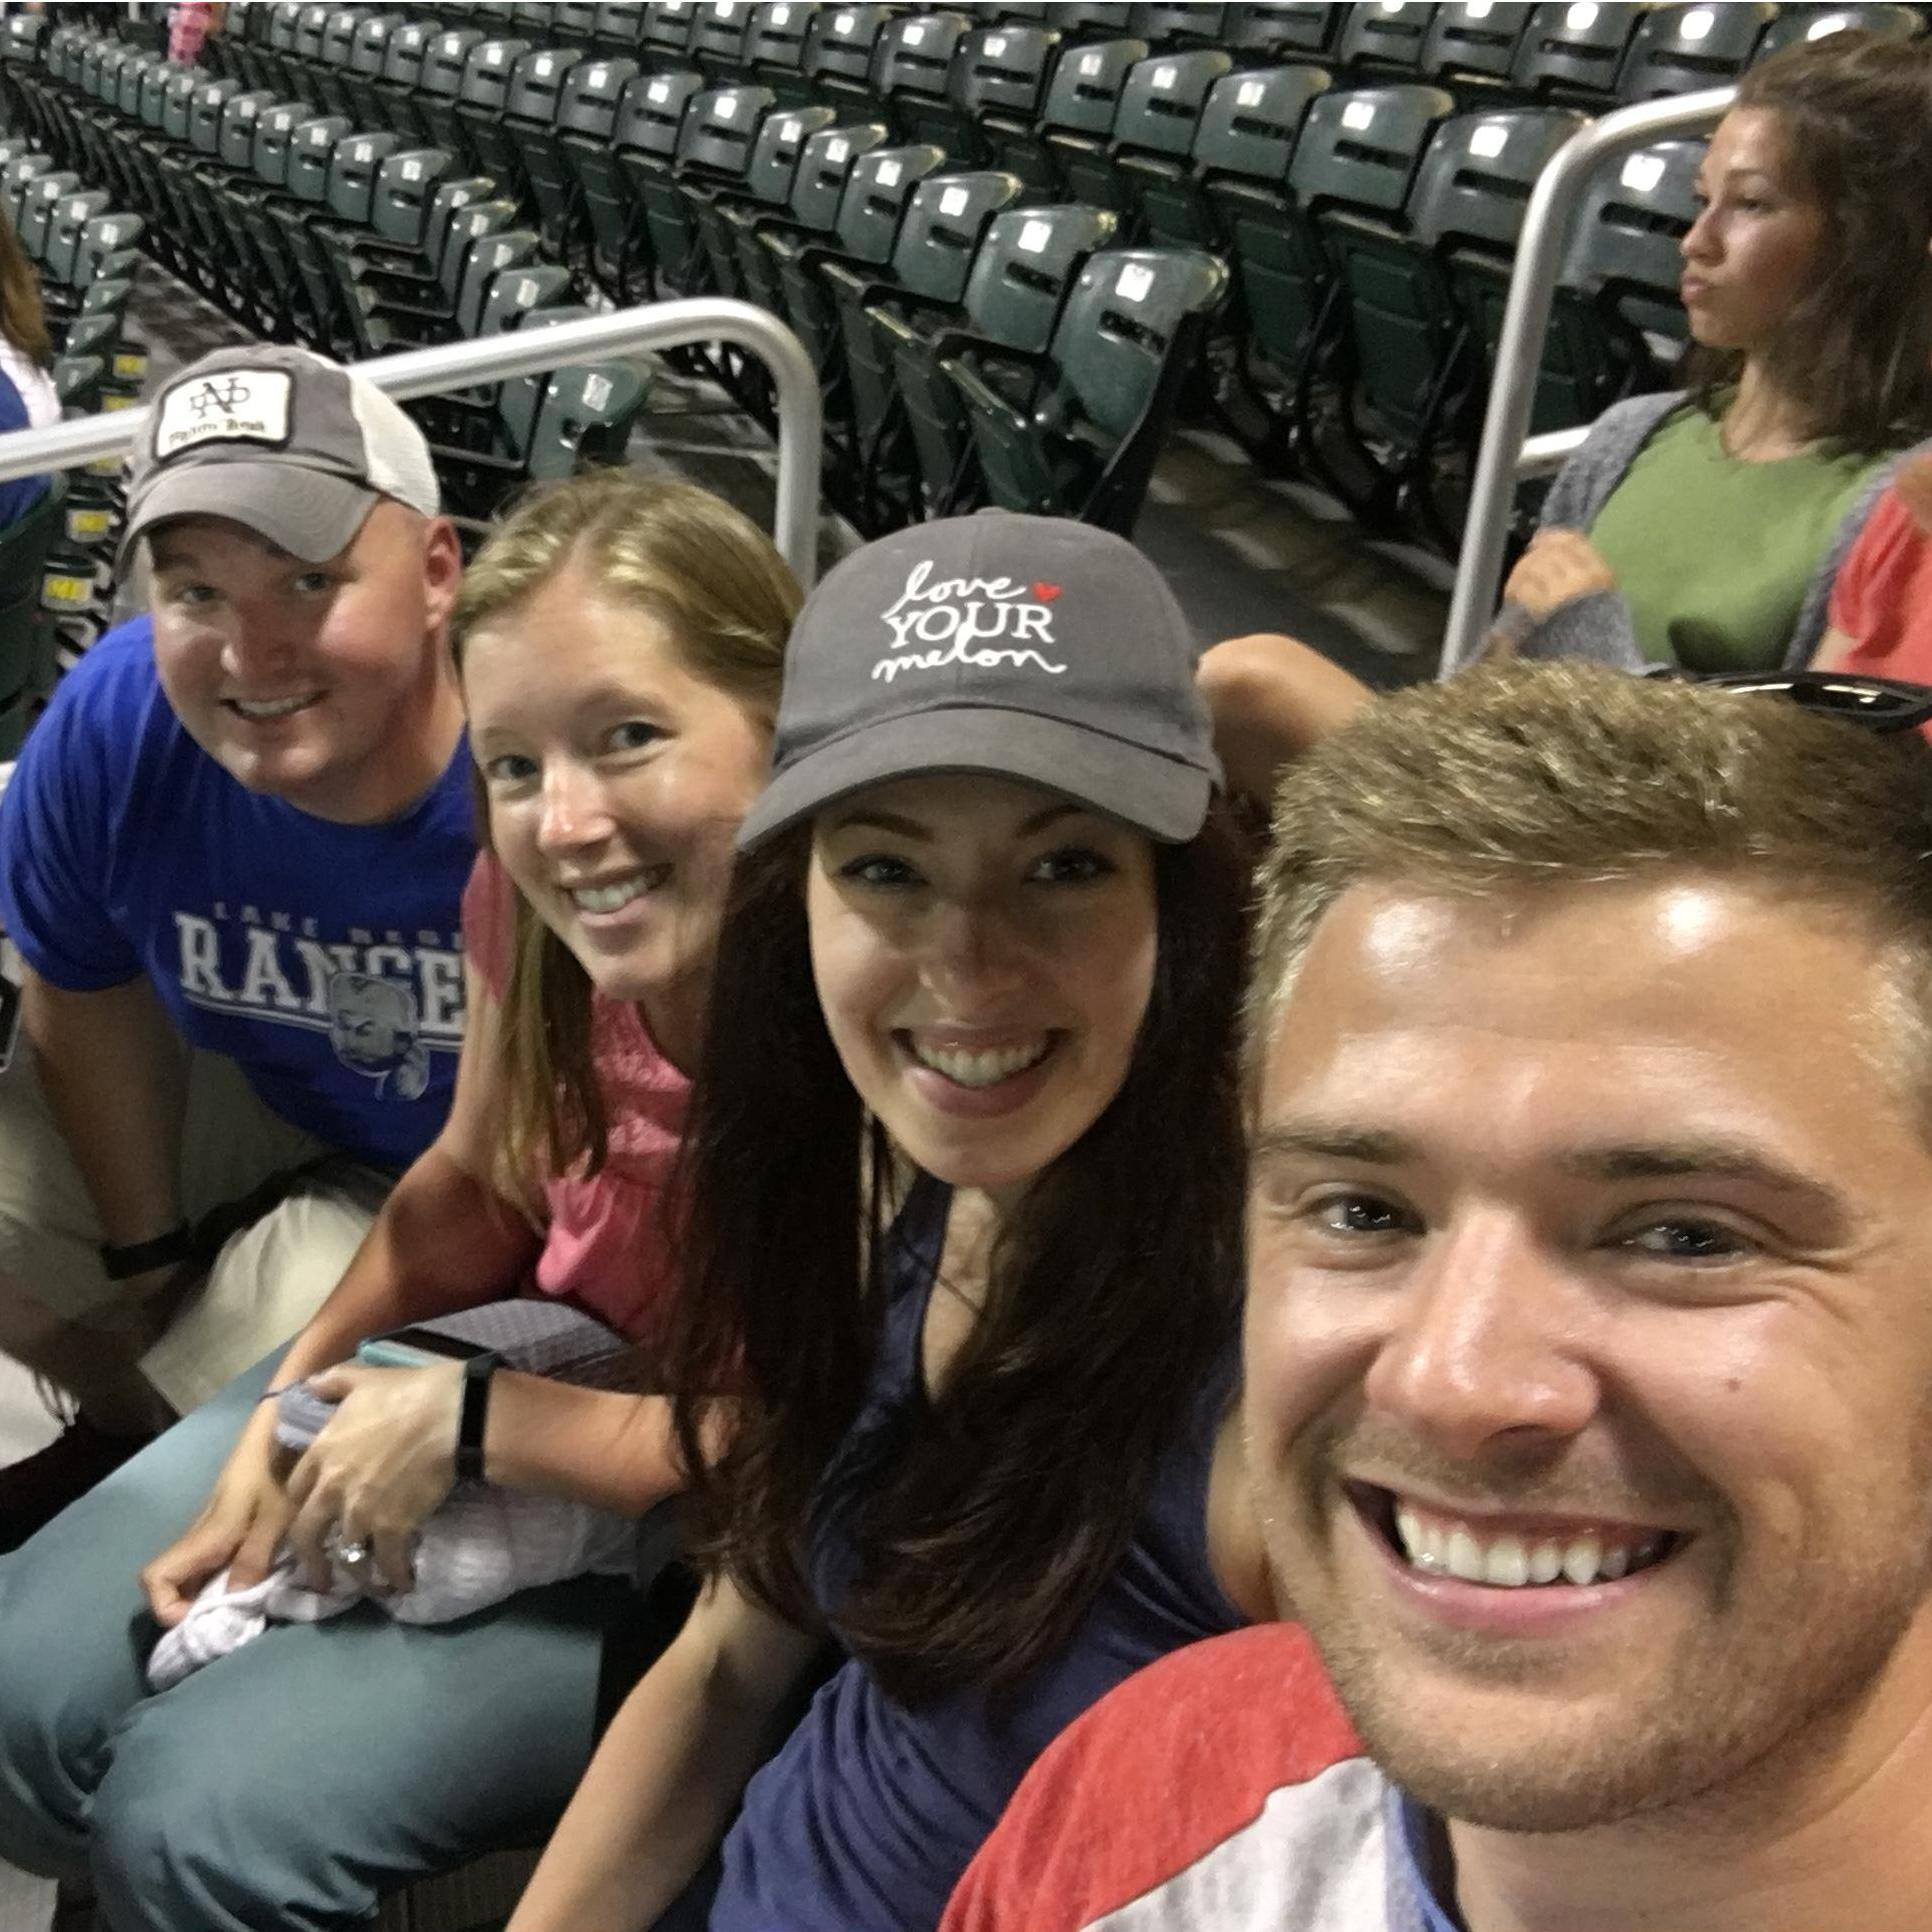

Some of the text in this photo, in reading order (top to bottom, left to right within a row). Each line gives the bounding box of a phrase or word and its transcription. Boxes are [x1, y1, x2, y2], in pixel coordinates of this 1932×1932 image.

[880, 559, 1028, 619] love
[870, 620, 1068, 684] melon
[884, 601, 1056, 649] YOUR
